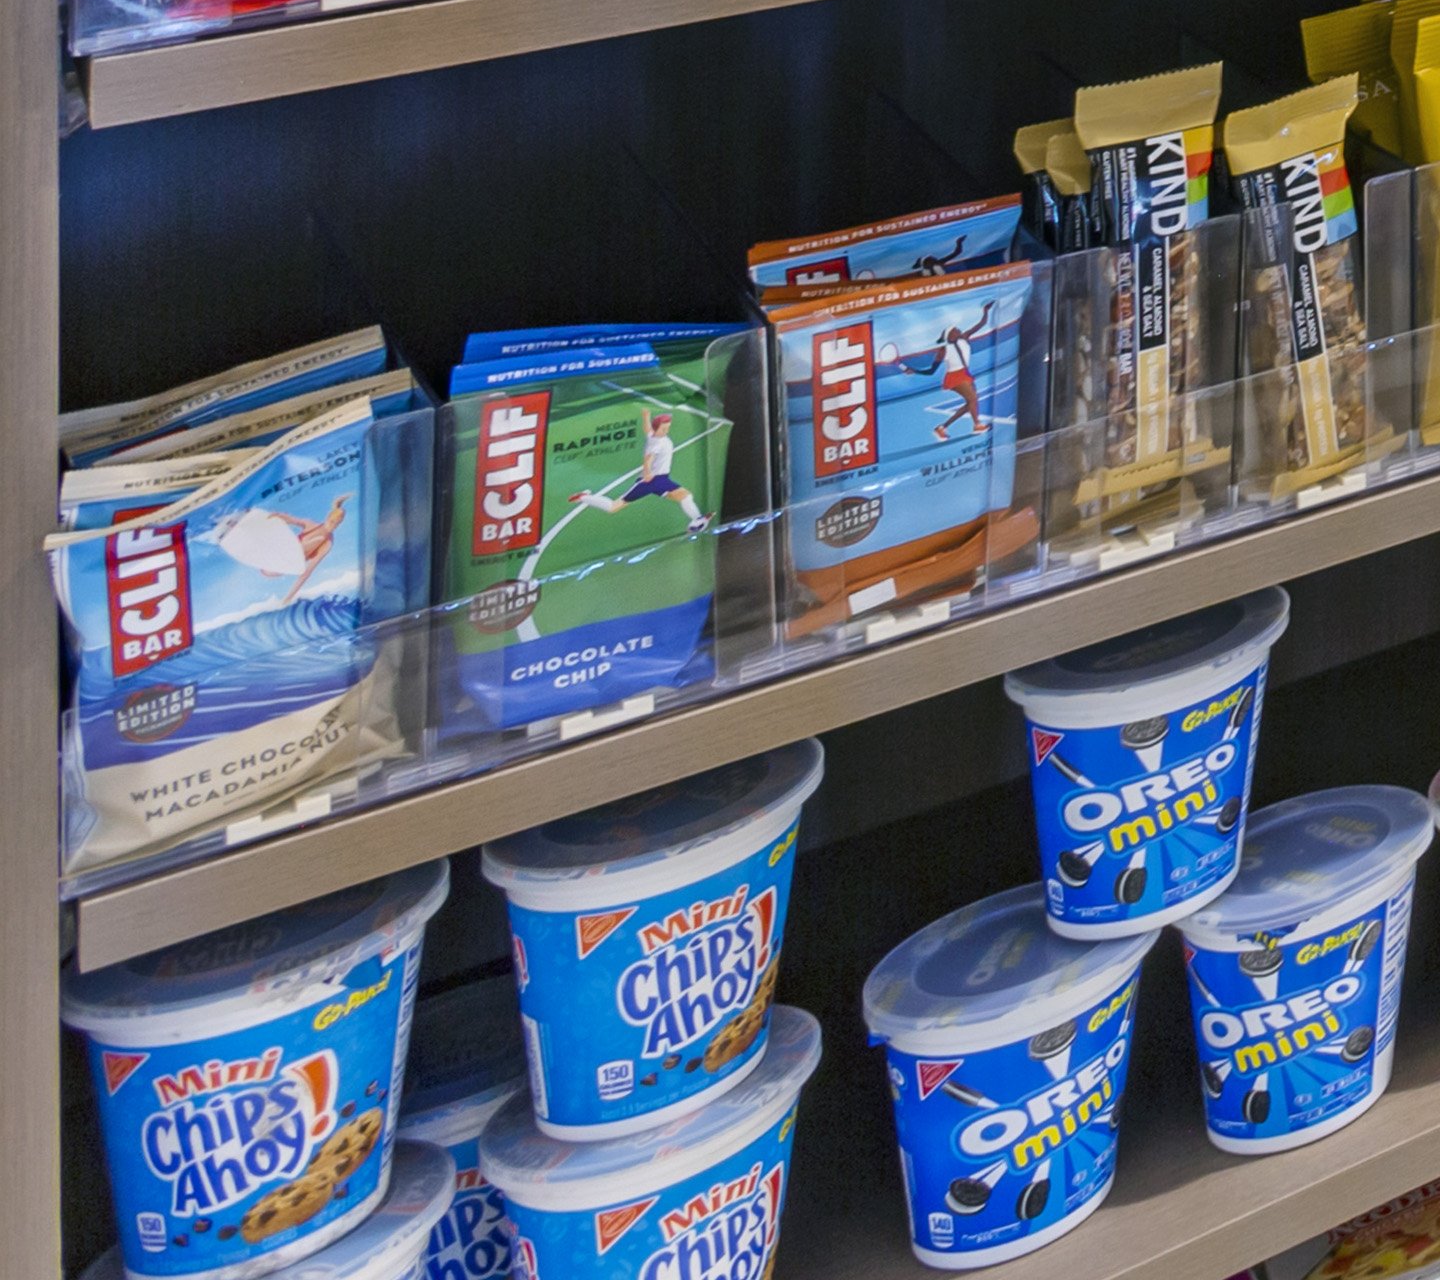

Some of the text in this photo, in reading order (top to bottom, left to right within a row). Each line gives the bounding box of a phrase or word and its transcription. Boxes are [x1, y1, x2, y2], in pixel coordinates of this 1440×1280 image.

[1146, 133, 1188, 236] KIND
[1281, 152, 1328, 253] KIND
[480, 404, 540, 516] CLIF
[552, 426, 637, 454] RAPINOE
[823, 439, 869, 464] BAR
[480, 516, 534, 543] BAR
[112, 523, 180, 636] CLIF
[123, 630, 183, 660] BAR
[510, 634, 654, 683] CHOCOLATE
[554, 662, 612, 690] CHIP
[130, 769, 211, 806] WHITE
[1064, 741, 1236, 831] OREO
[1110, 778, 1217, 854] mini
[619, 909, 755, 1025] Chips
[1200, 974, 1360, 1047] OREO
[156, 1047, 279, 1103] Mini
[959, 1037, 1128, 1156] OREO
[145, 1078, 304, 1179] Chips
